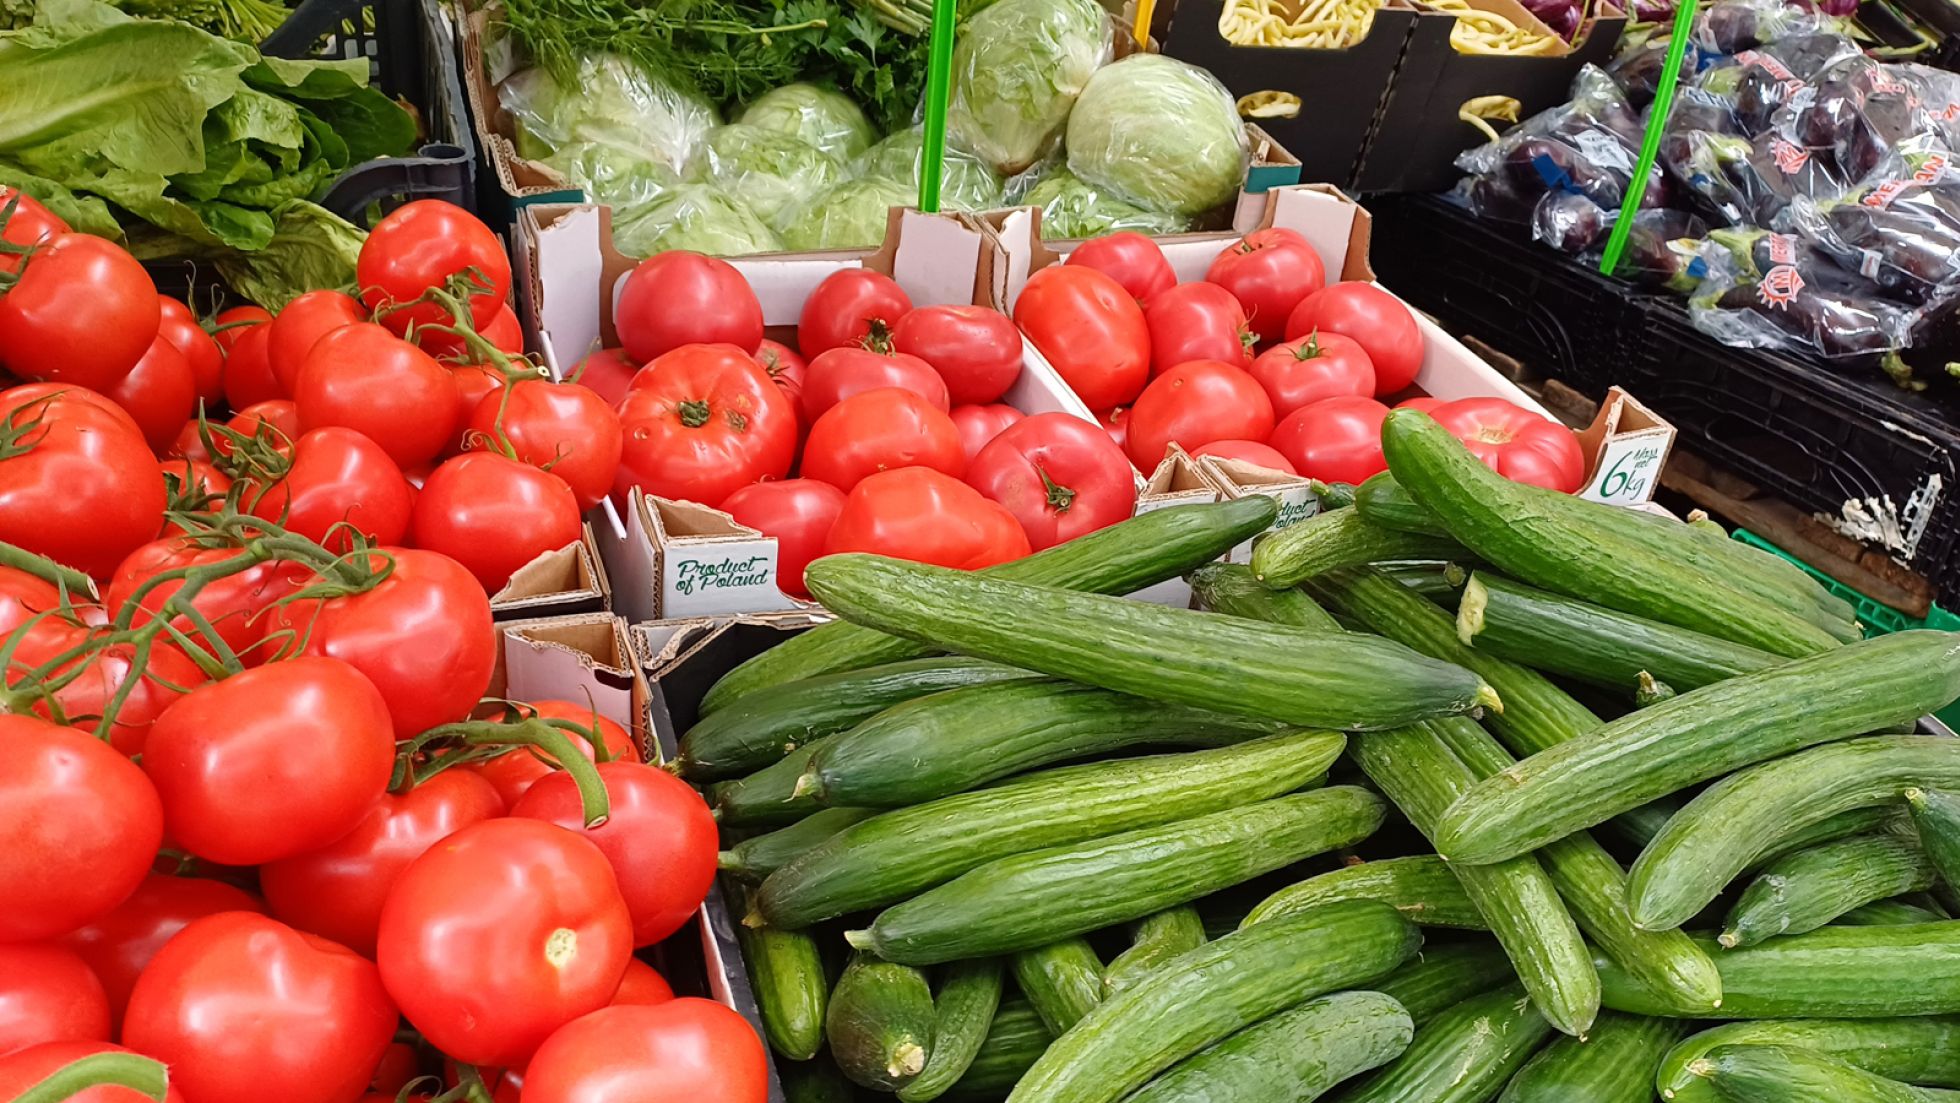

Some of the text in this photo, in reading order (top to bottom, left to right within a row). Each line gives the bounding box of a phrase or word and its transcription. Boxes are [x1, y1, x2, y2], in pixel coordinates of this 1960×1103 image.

[677, 556, 768, 578] Product
[675, 569, 768, 596] of Poland
